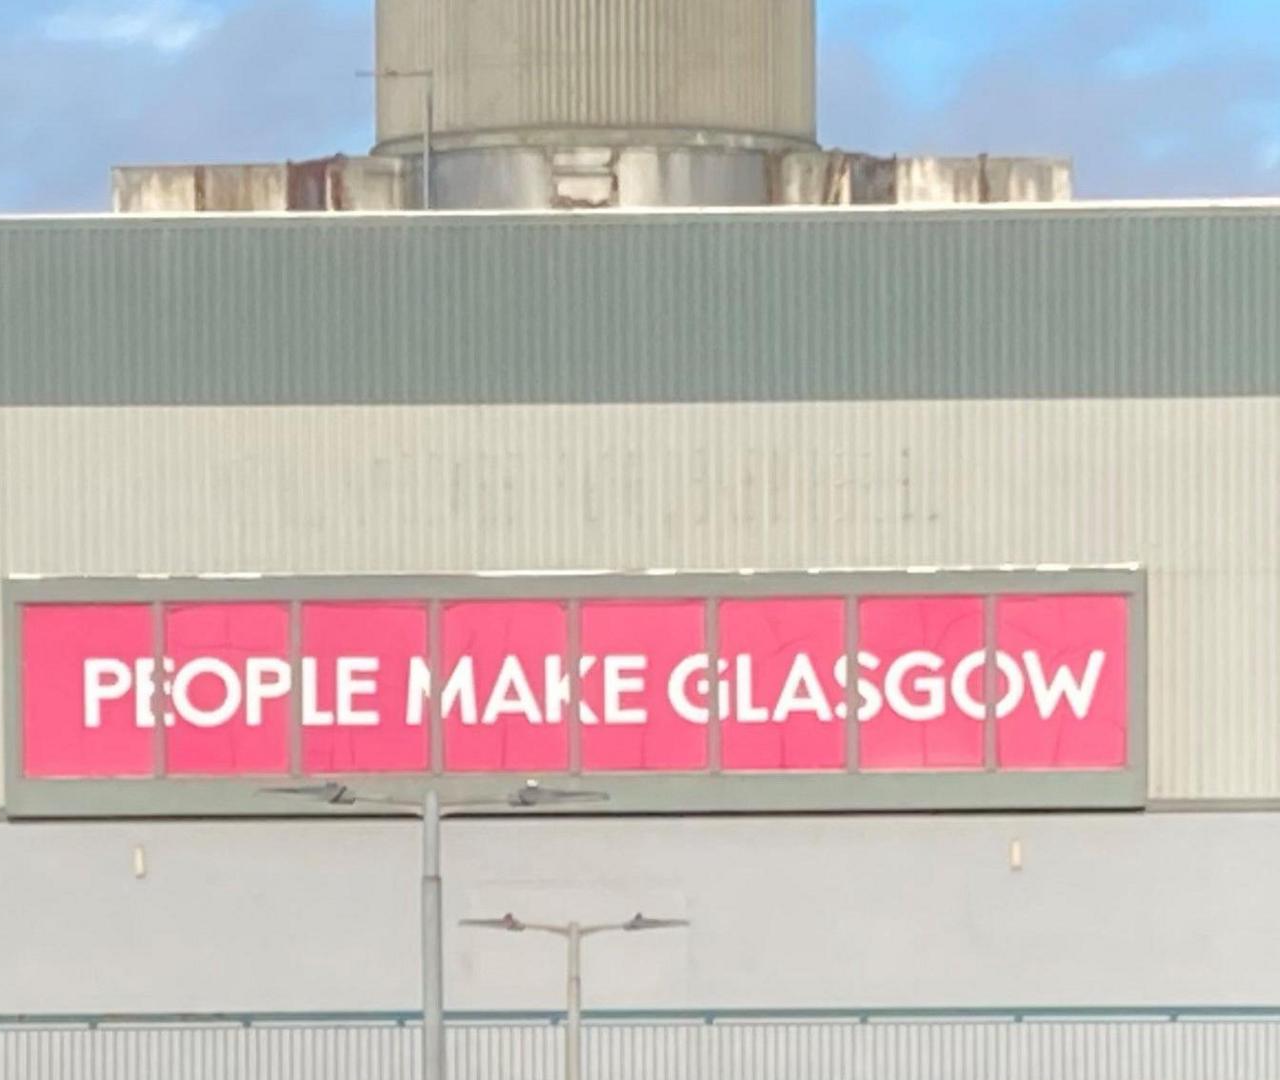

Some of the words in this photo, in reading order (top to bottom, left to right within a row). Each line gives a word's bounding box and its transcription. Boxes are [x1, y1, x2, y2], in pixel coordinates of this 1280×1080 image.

[83, 656, 379, 727] PEOPLE
[407, 654, 646, 725] MAKE
[667, 650, 1106, 723] GLASGOW
